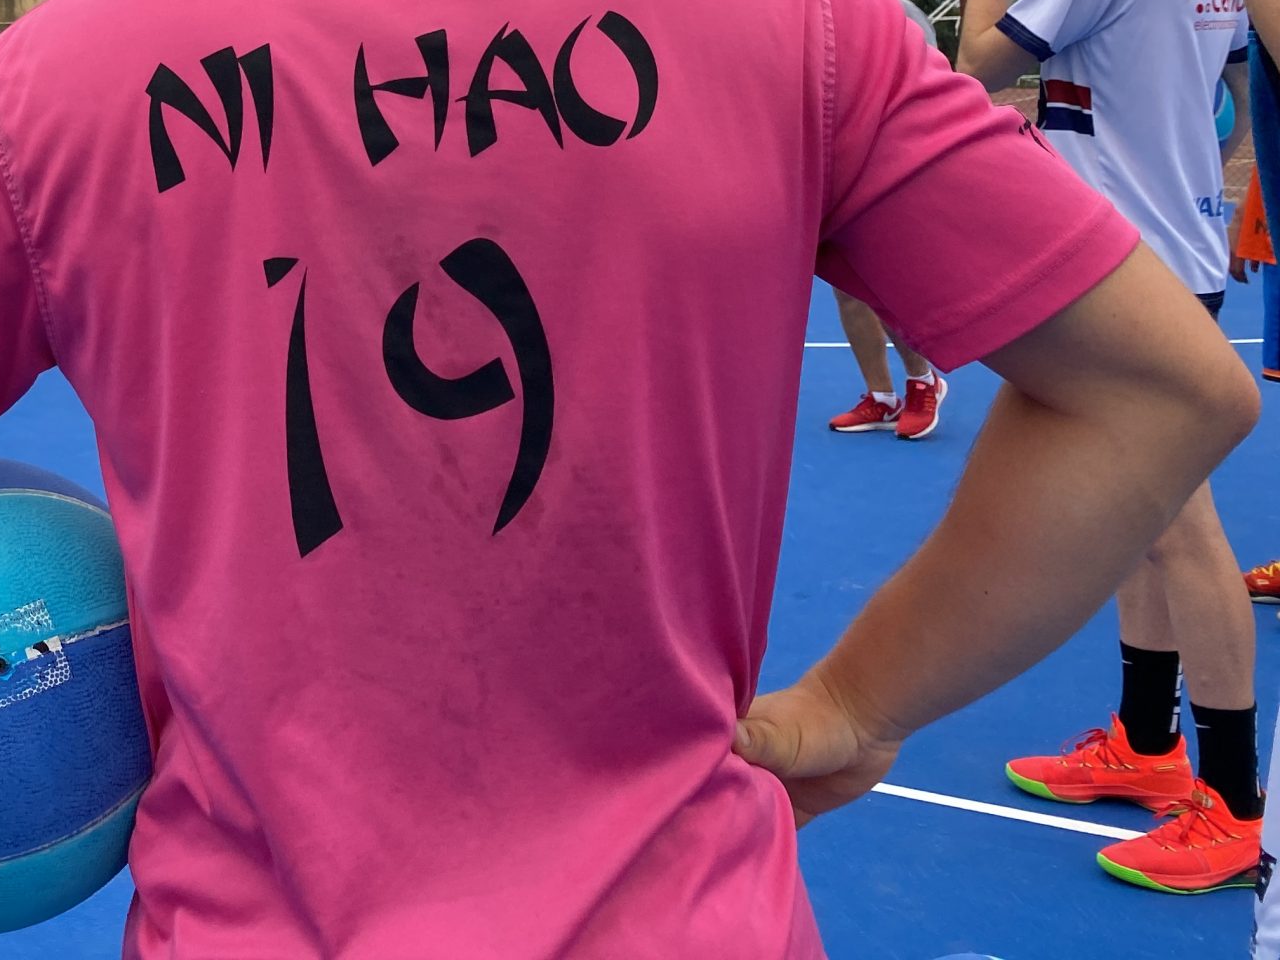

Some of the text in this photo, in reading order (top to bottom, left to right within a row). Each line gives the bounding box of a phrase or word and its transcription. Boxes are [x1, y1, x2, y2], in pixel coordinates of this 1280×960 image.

[145, 11, 659, 193] NI HAO
[263, 237, 555, 558] 19
